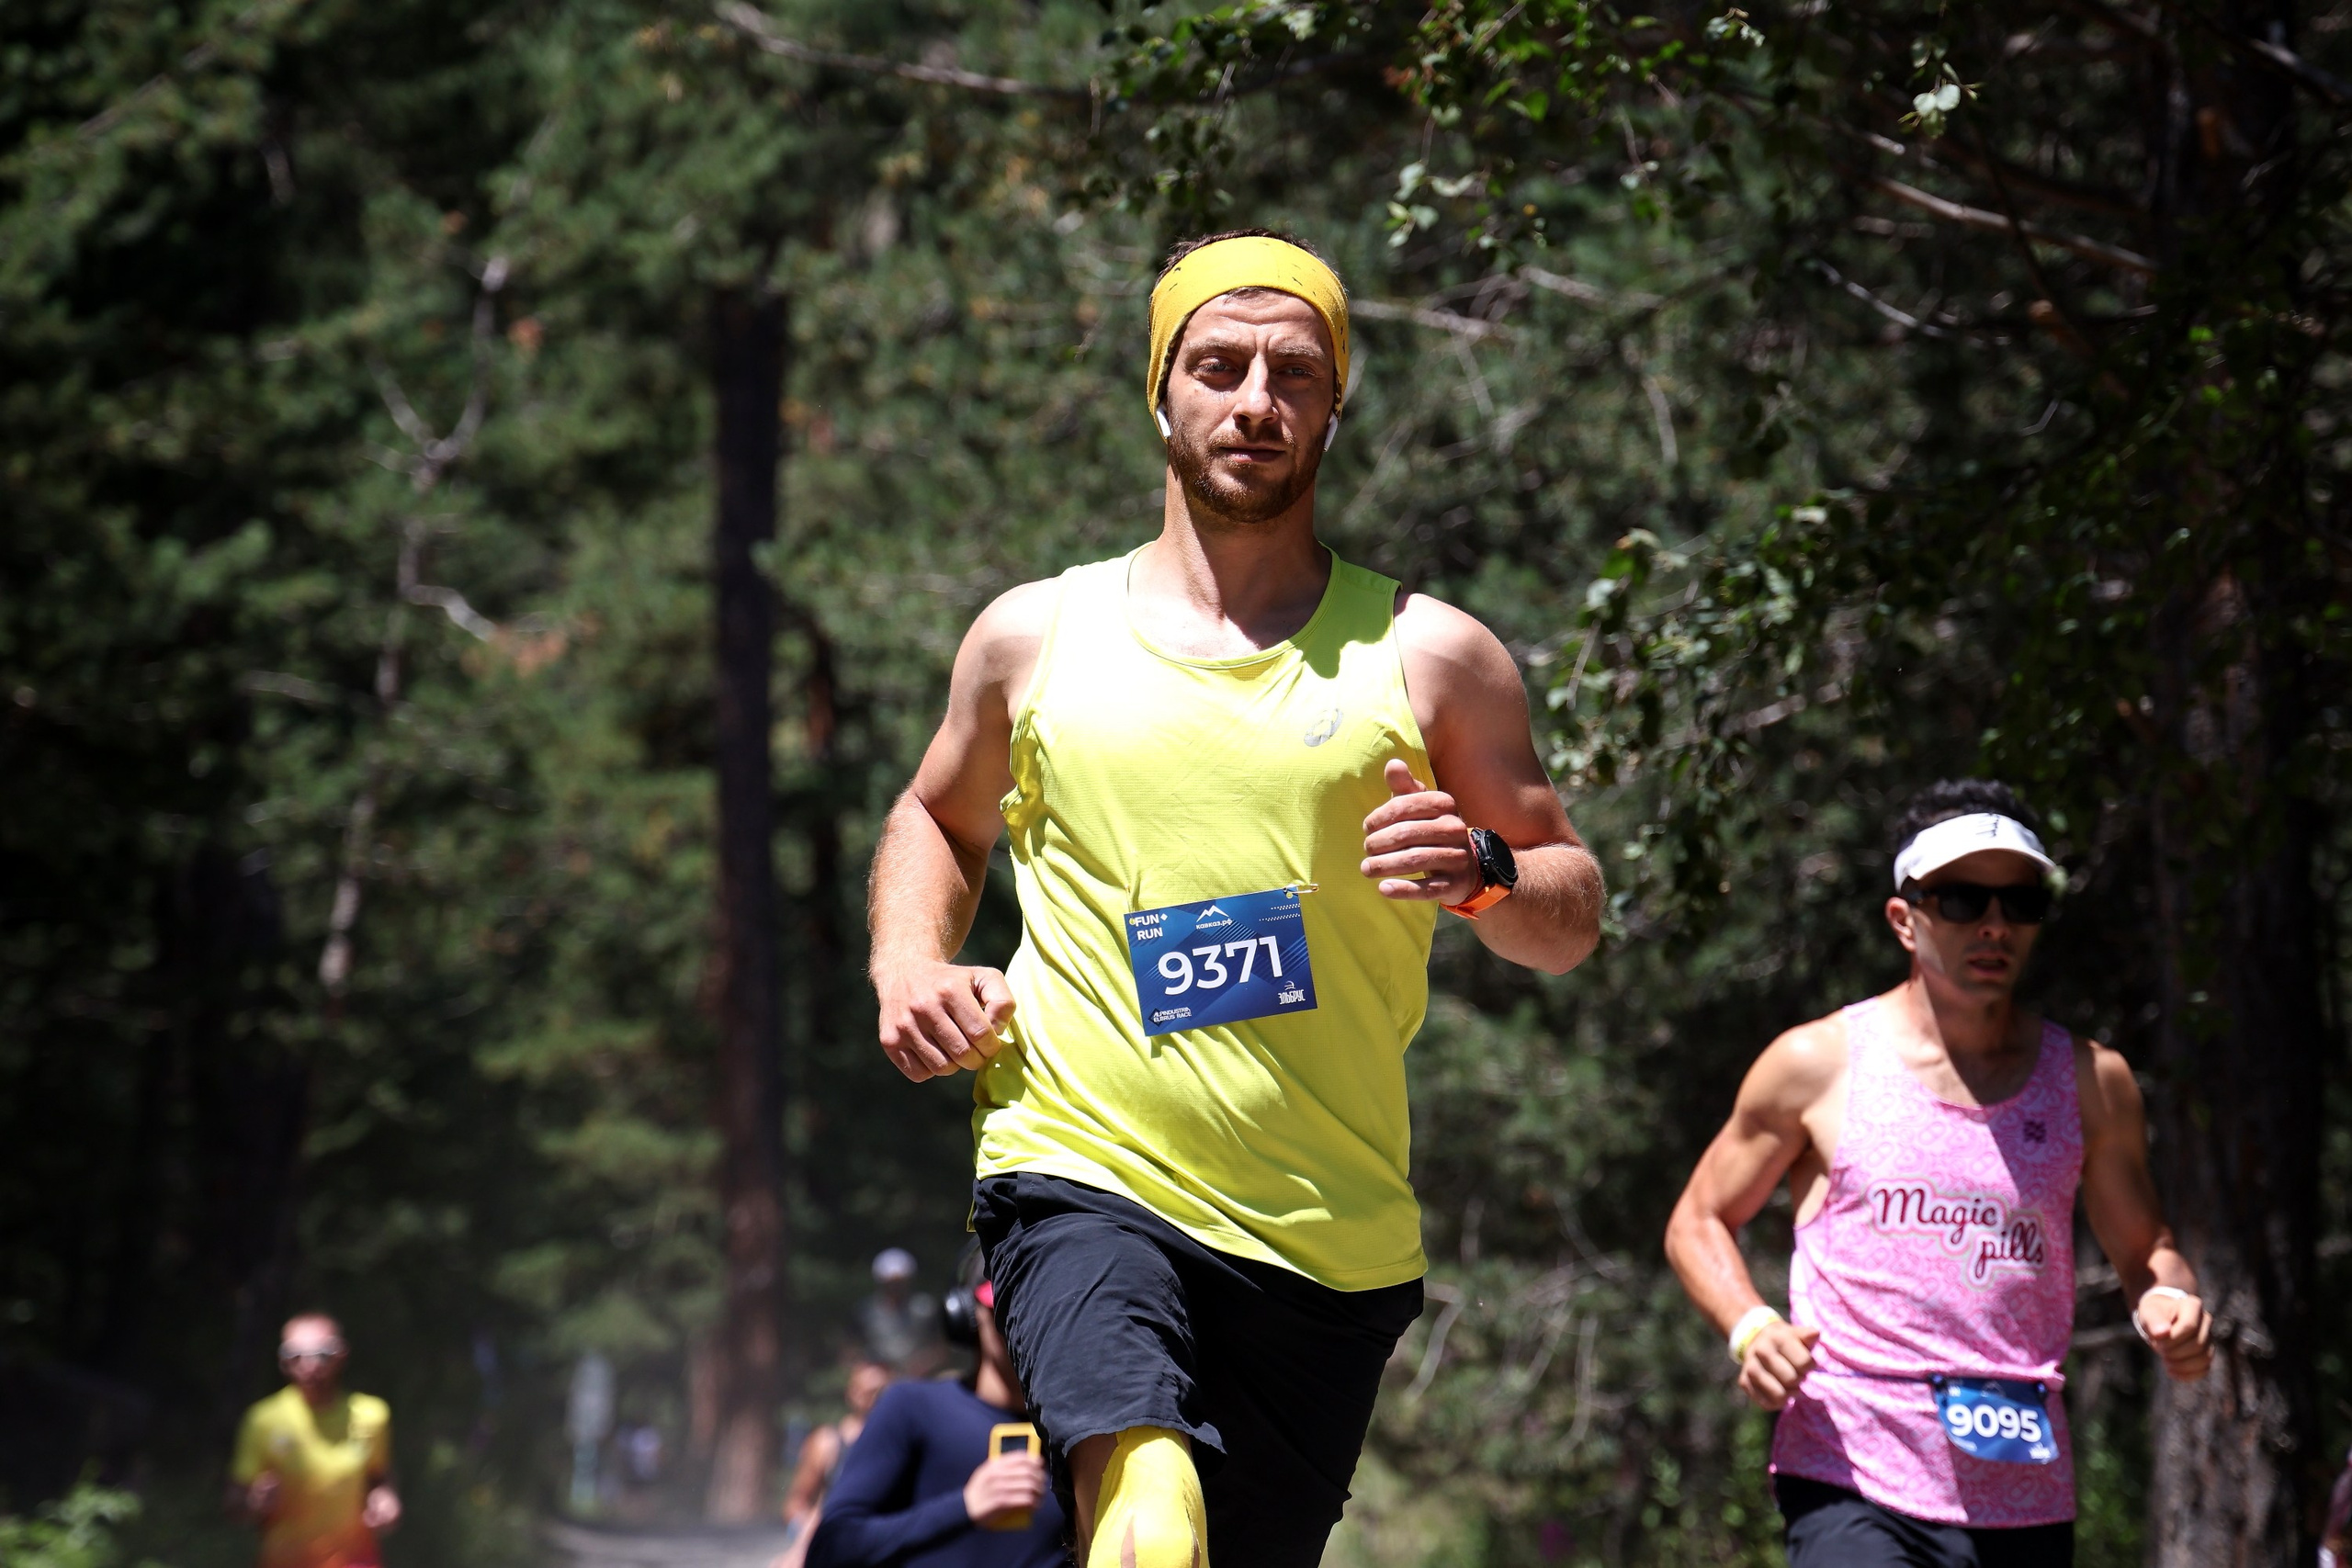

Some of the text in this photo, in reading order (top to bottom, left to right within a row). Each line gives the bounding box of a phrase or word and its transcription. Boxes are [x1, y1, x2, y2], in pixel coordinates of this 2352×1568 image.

[1135, 914, 1159, 927] FUN
[1136, 927, 1163, 941] RUN
[1195, 918, 1234, 931] кавказ.рф
[1158, 935, 1283, 996] 9371
[1277, 988, 1306, 1005] ЭЛЬБРУС
[1874, 1189, 1997, 1245] Magic
[1975, 1221, 2043, 1280] pills
[1946, 1403, 2042, 1443] 9095
